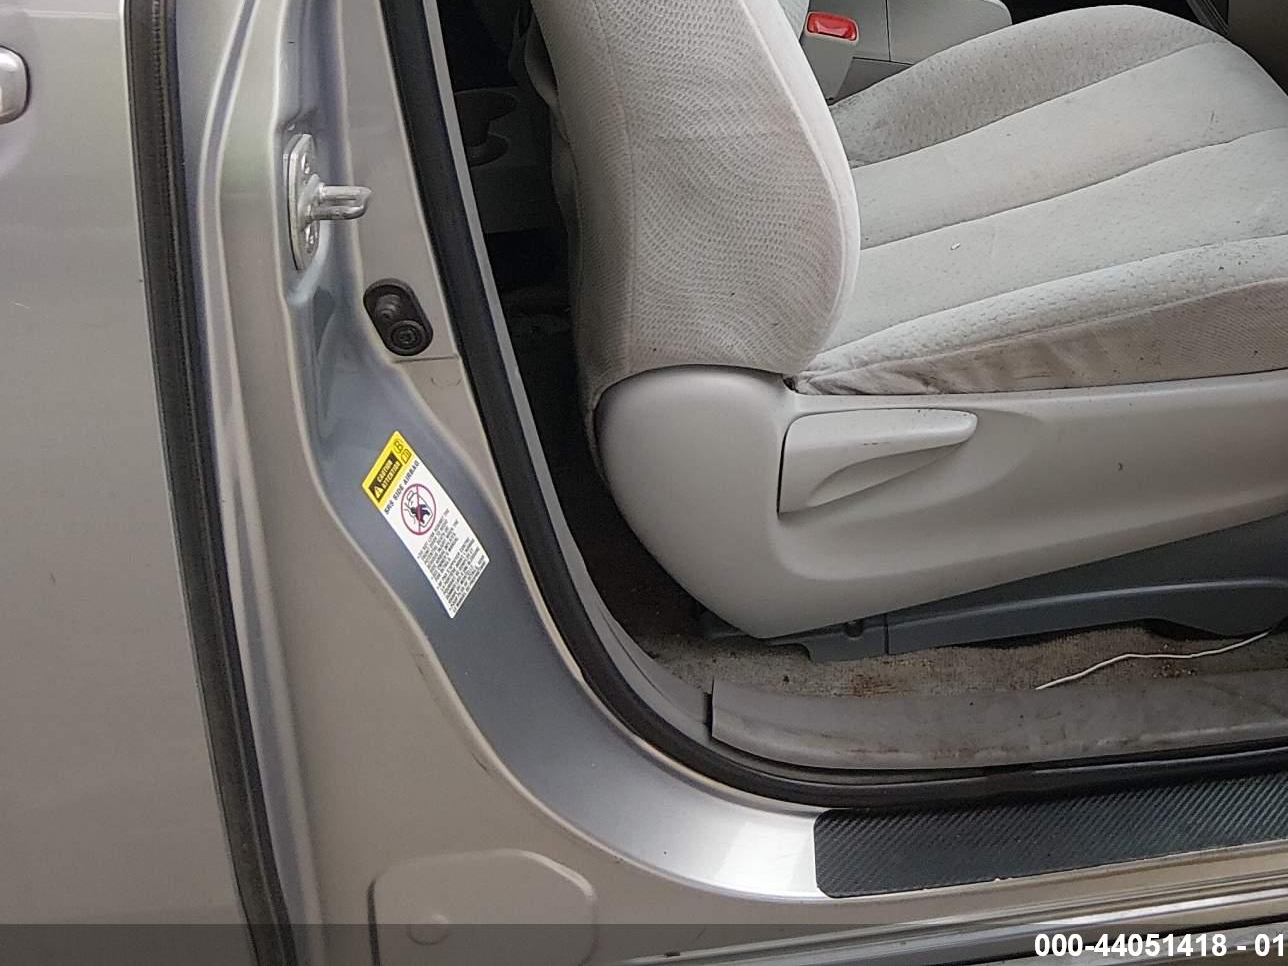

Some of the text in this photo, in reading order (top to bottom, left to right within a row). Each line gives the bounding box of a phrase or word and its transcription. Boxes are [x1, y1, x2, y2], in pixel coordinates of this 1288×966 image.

[377, 460, 393, 482] CAUTION
[380, 460, 401, 490] ATTENTION
[384, 459, 420, 515] SRS SIDE AIRBAG
